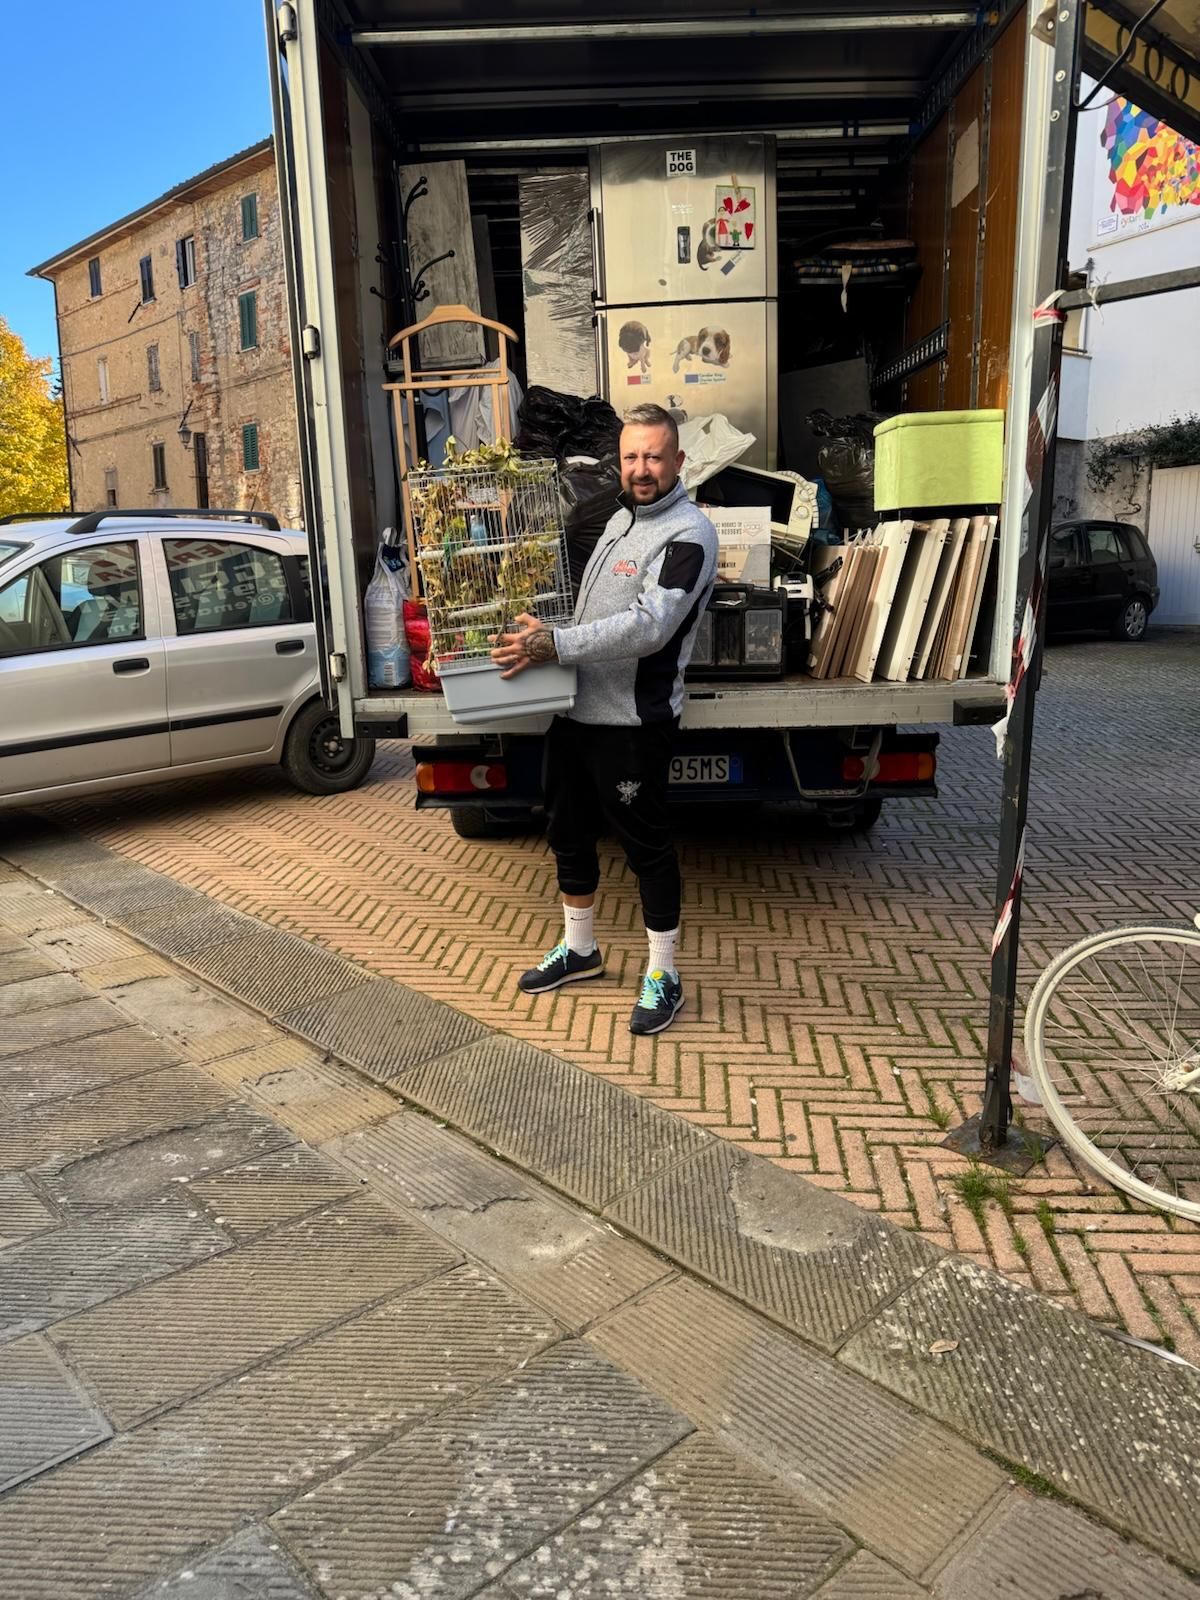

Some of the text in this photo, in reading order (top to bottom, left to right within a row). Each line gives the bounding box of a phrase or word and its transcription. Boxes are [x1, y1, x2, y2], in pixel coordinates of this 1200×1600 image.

[670, 151, 692, 162] THE
[669, 162, 694, 172] DOG
[671, 757, 727, 781] 95MS
